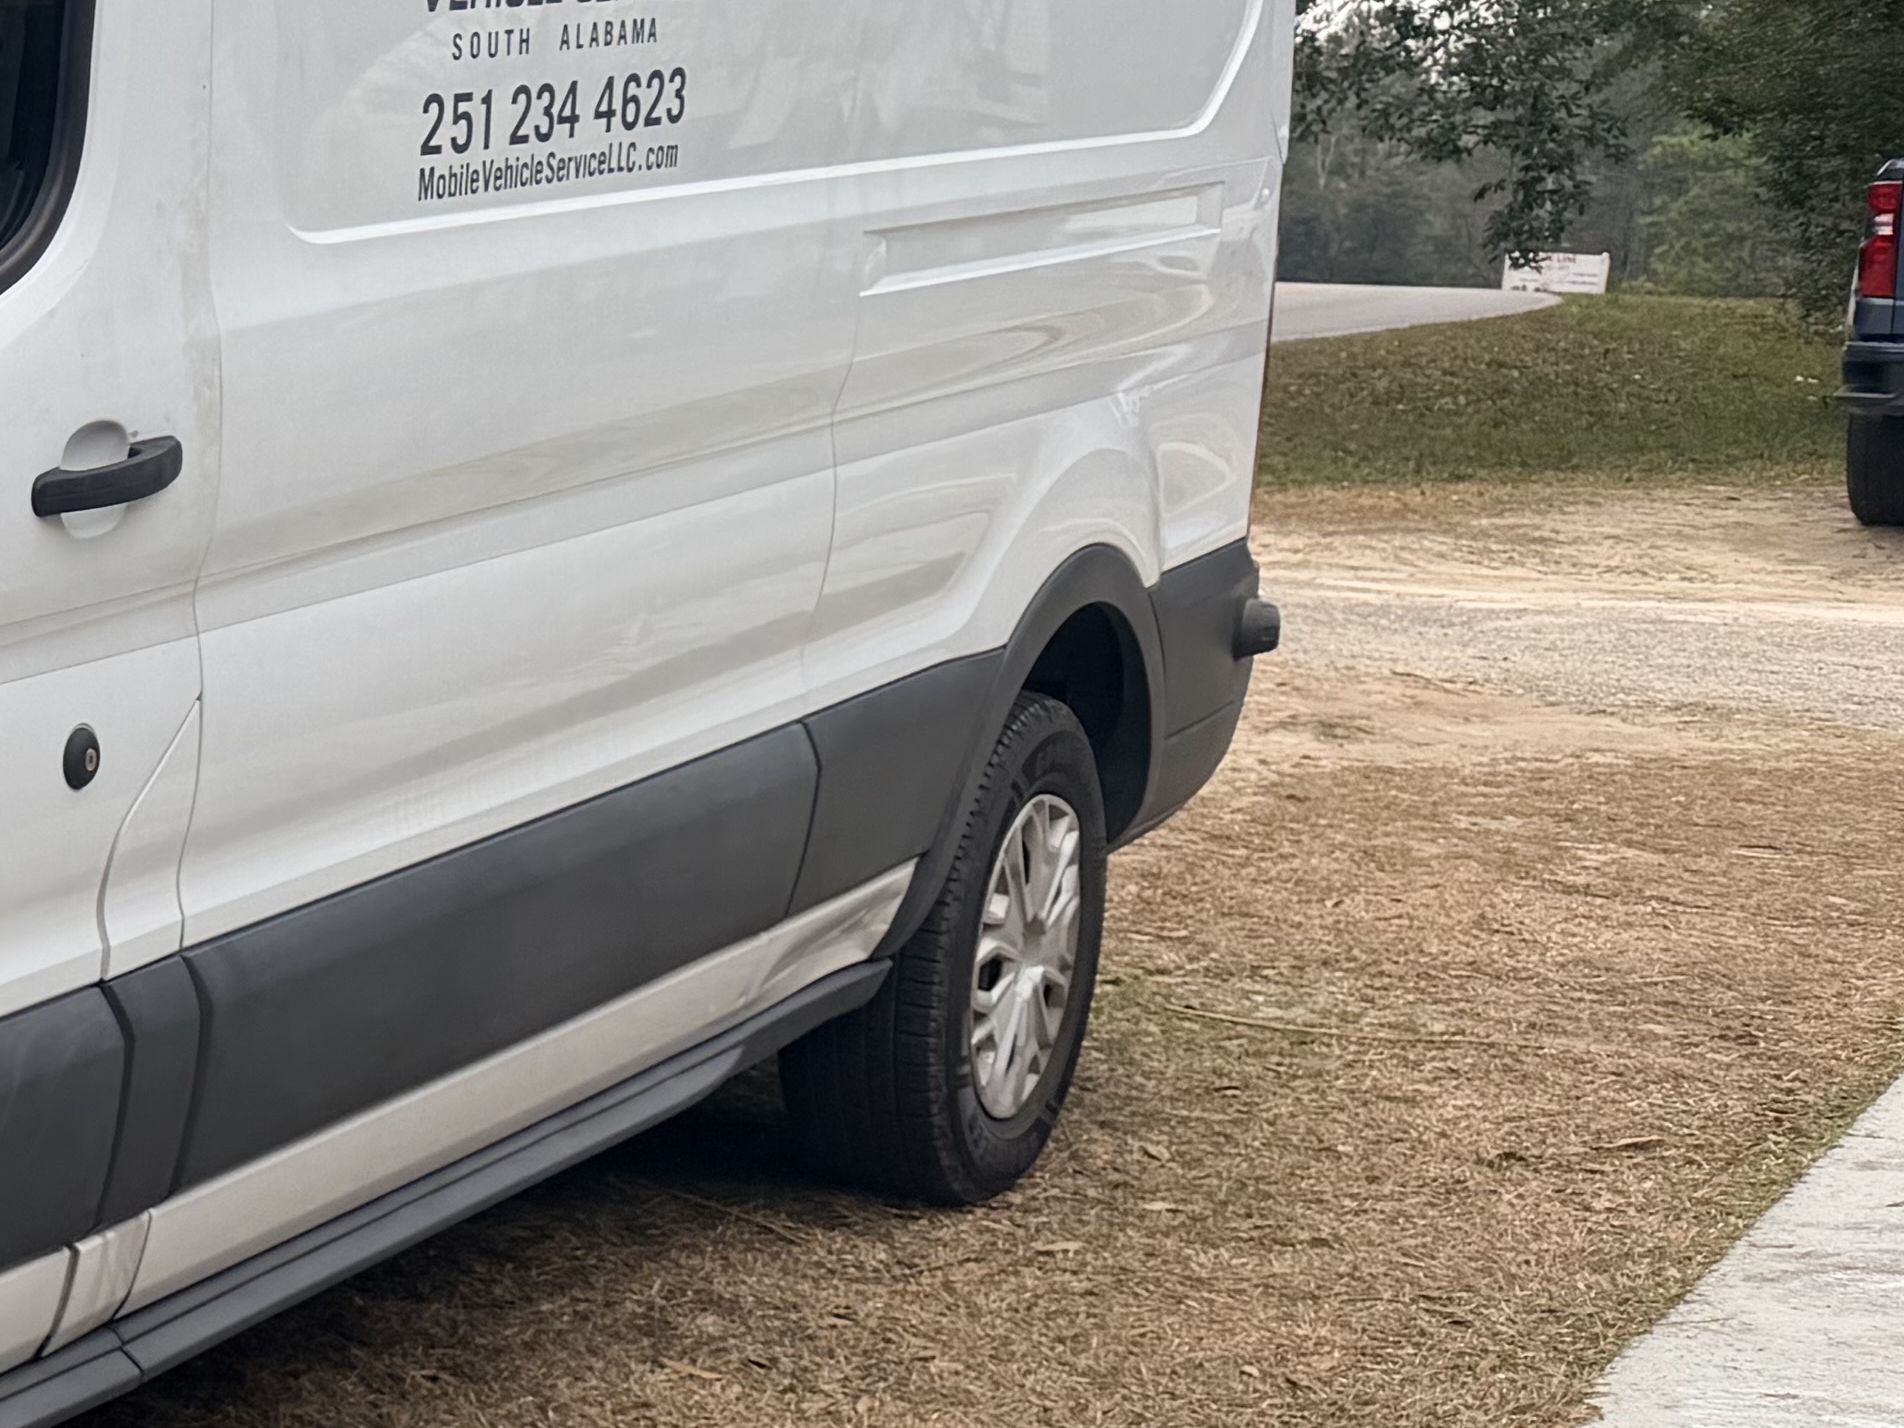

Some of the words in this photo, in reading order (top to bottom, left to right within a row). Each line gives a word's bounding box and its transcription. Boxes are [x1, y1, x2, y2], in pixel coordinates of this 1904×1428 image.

[452, 27, 531, 60] SOUTH
[559, 18, 658, 50] ALABAMA
[419, 89, 494, 156] 251
[509, 80, 581, 144] 234
[594, 68, 687, 133] 4623
[418, 139, 679, 202] MobileVehicleServiceLLC.com
